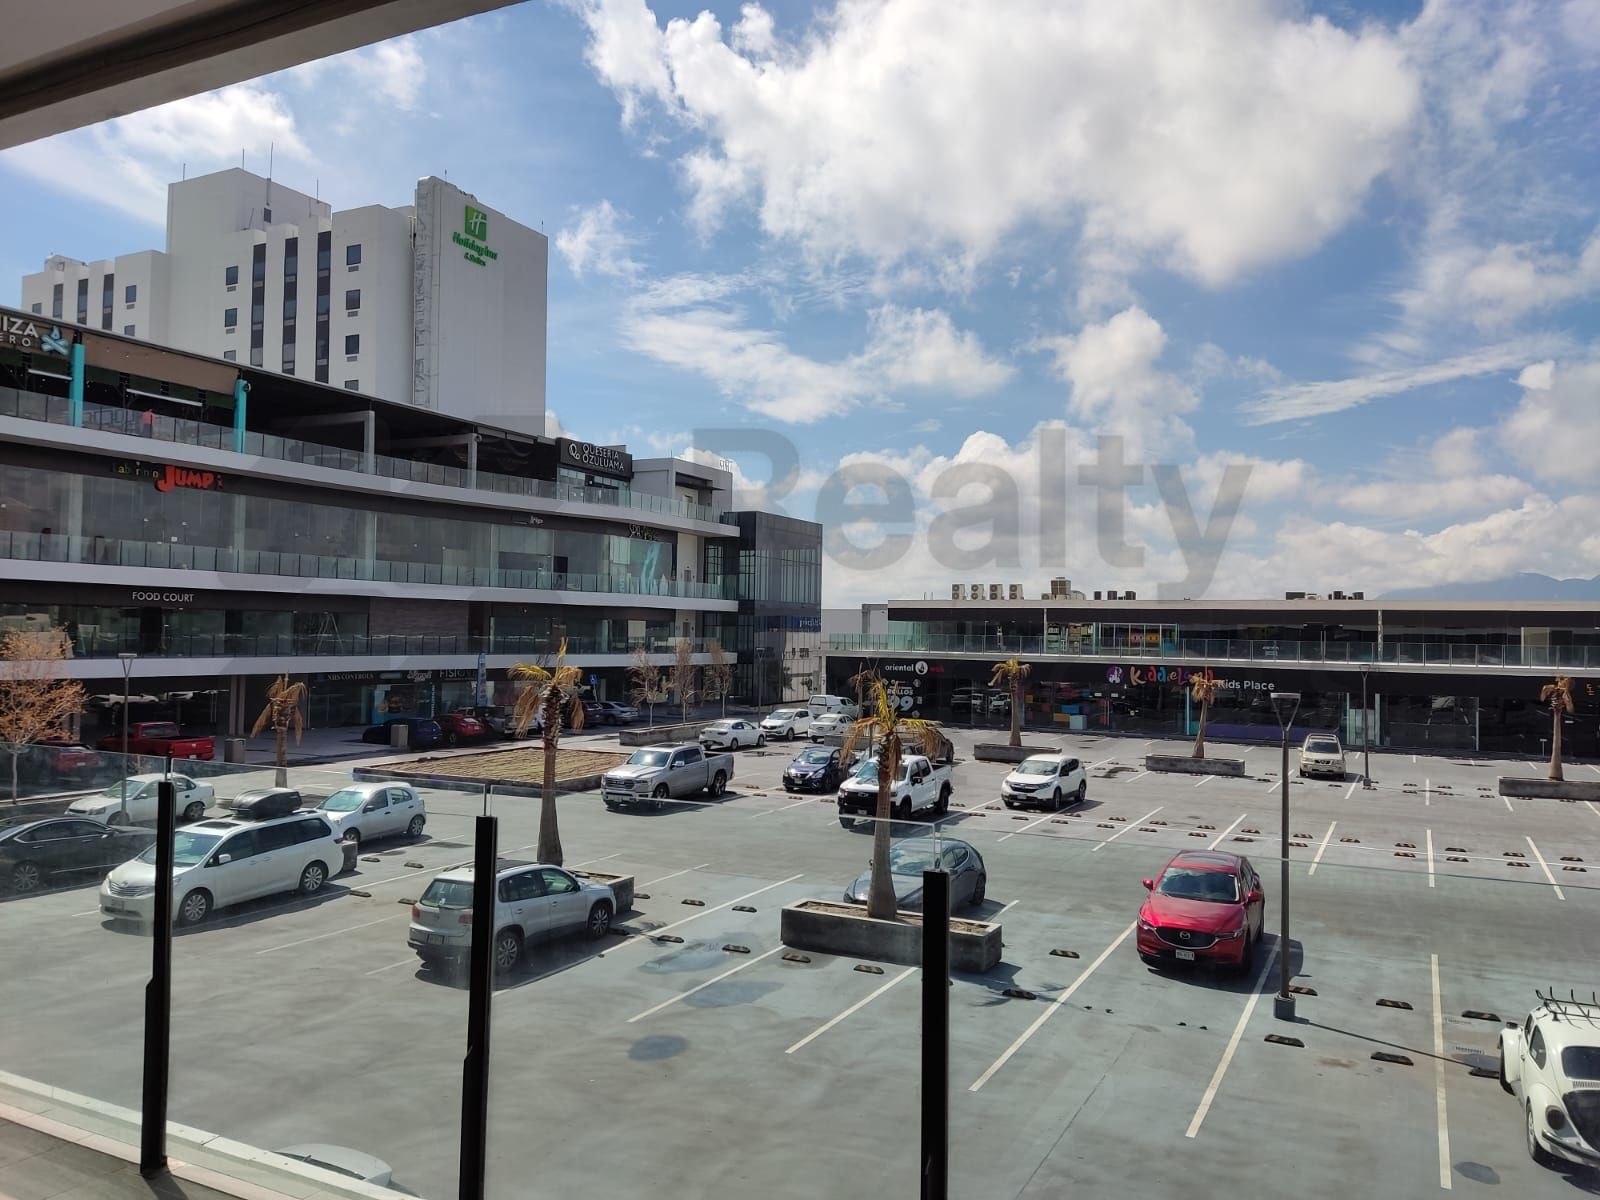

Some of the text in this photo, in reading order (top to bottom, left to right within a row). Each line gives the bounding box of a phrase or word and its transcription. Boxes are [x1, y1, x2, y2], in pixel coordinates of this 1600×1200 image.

[0, 315, 39, 338] IZA
[582, 454, 625, 471] OZULUAMA
[132, 591, 194, 602] FOOD COURT
[884, 663, 914, 672] oriental
[1217, 678, 1241, 689] Kids
[1243, 679, 1275, 690] Place
